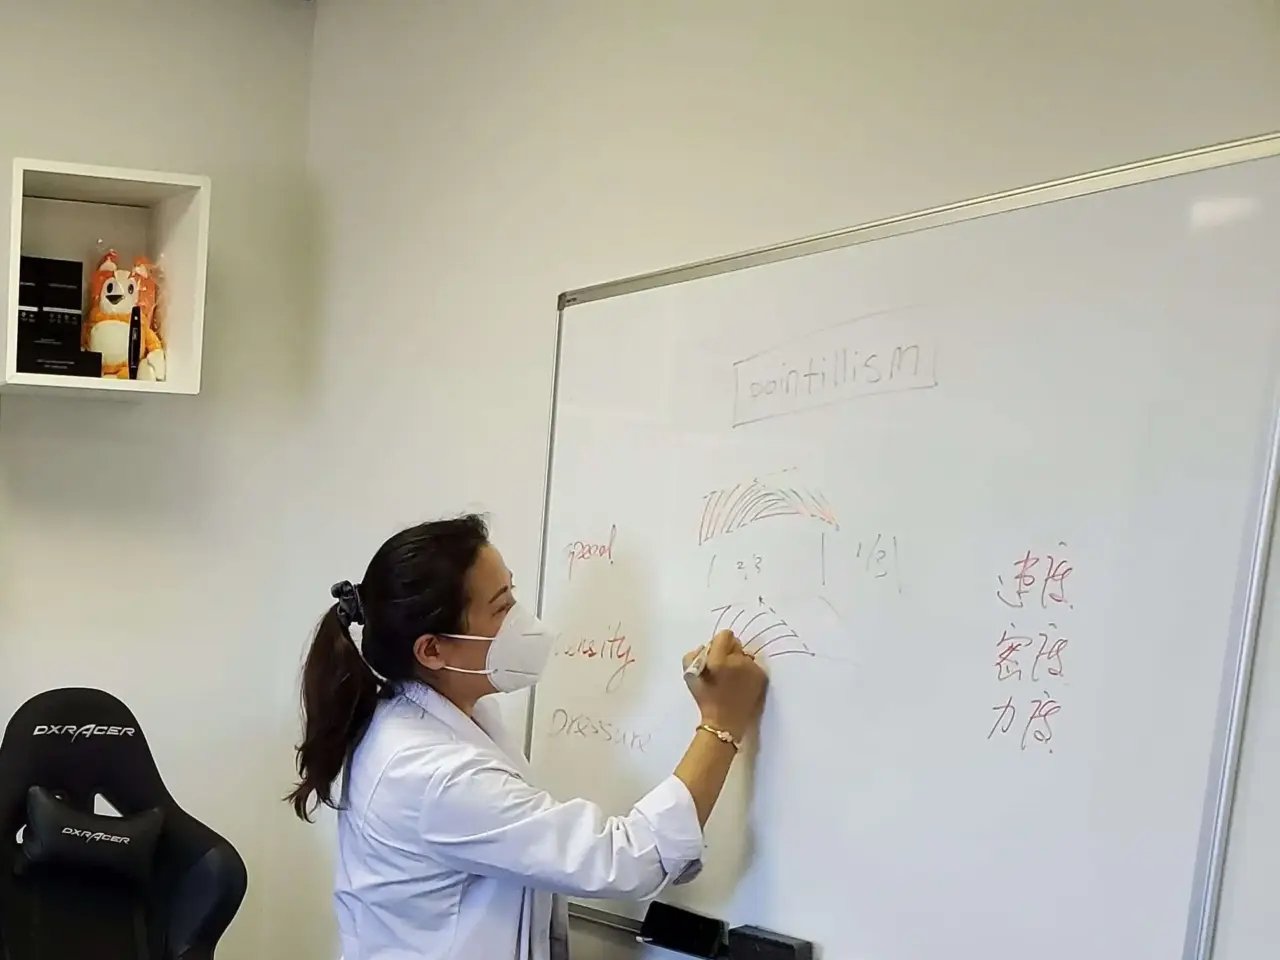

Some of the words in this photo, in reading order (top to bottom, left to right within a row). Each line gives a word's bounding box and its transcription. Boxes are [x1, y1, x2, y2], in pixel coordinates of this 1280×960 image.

[987, 690, 1062, 755] 力度
[32, 724, 136, 743] DXRACER
[61, 827, 131, 845] DXRACER
